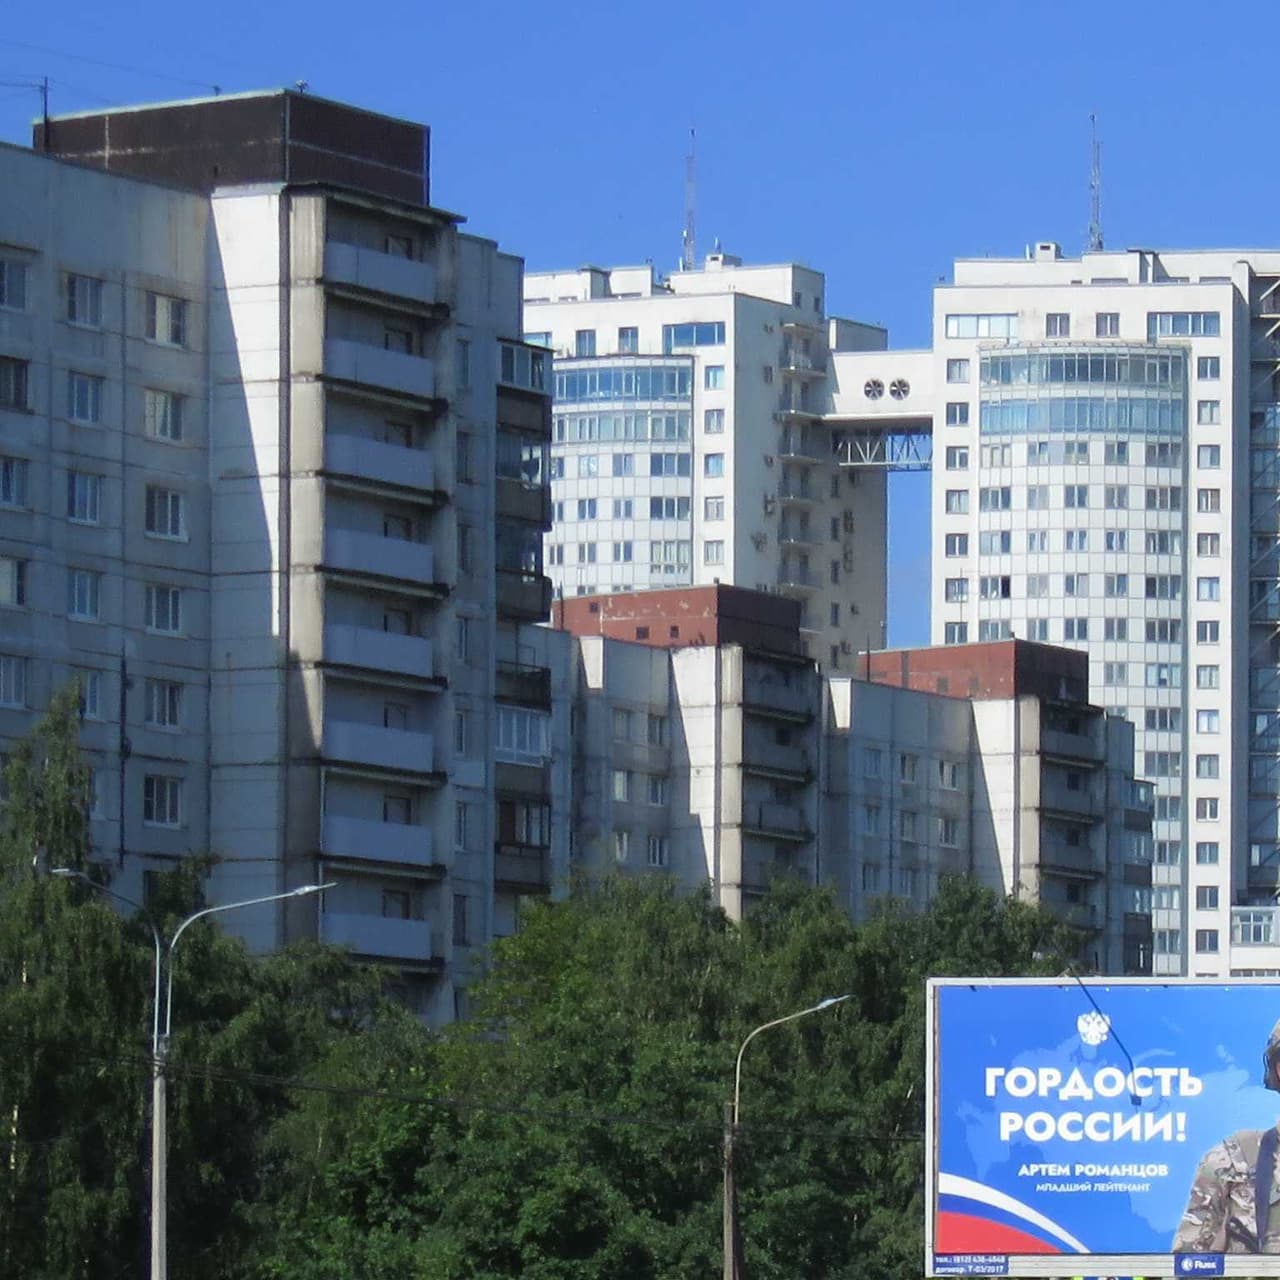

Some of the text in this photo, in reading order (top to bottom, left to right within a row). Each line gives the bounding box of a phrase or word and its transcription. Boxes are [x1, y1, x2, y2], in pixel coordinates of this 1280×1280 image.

[985, 1066, 1204, 1101] ГОРДОСТЬ
[999, 1111, 1187, 1142] РОССИИ!
[1018, 1163, 1169, 1178] АРТЕМ РОМАНЦОВ
[1036, 1181, 1150, 1193] МЛАДШИЙ ЛЕЙТЕНАНТ
